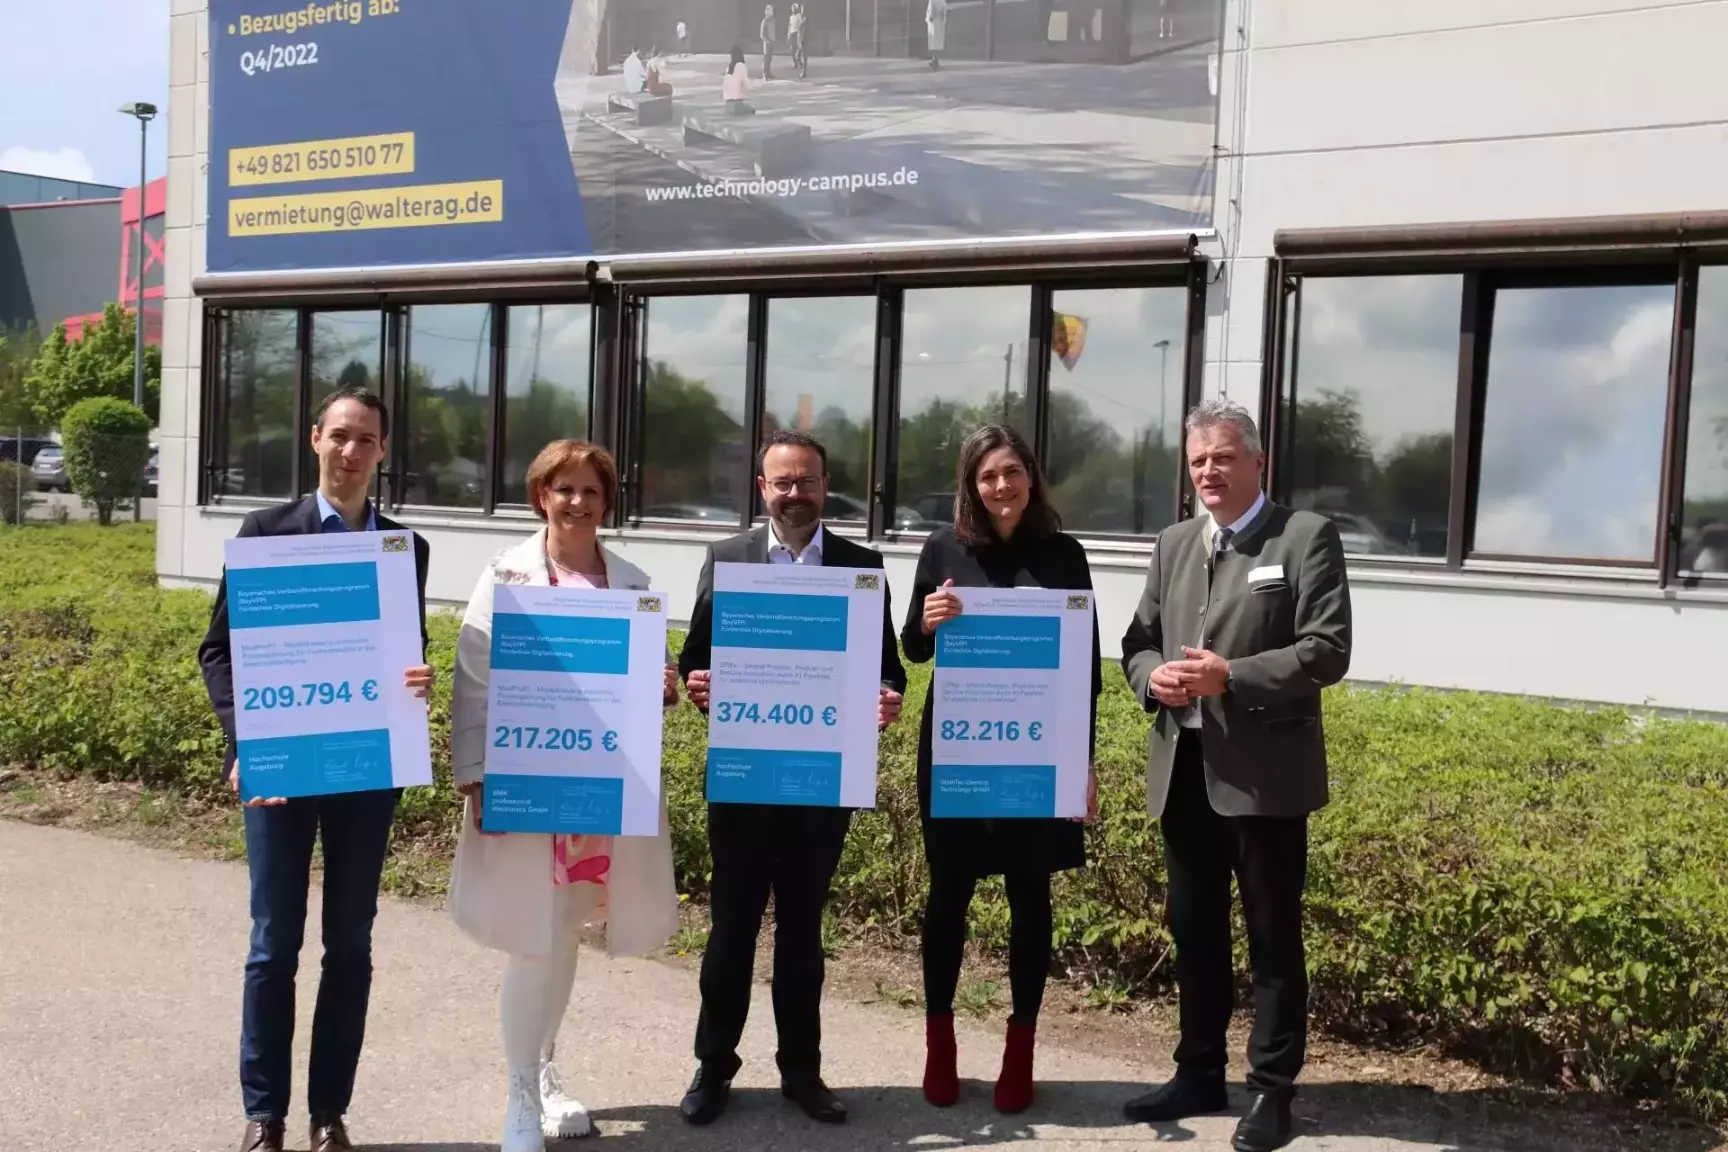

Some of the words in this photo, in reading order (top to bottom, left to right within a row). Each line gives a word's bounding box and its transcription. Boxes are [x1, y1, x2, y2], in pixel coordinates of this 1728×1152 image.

[240, 1, 362, 36] Bezugsfertig
[368, 0, 400, 17] ab:
[240, 42, 319, 76] Q4/2022
[236, 155, 269, 175] +49
[272, 152, 301, 173] 821
[306, 149, 341, 171] 650
[345, 145, 376, 168] 510
[380, 142, 404, 164] 77
[646, 166, 919, 201] www.technology-campus.de
[235, 191, 493, 227] vermietung@walterag.de
[243, 681, 352, 711] 209.794
[361, 679, 379, 702] €
[716, 701, 814, 725] 374.400
[821, 705, 837, 726] €
[940, 719, 1020, 741] 82.216
[1027, 721, 1043, 741] €
[493, 726, 593, 751] 217.205
[601, 730, 618, 752] €
